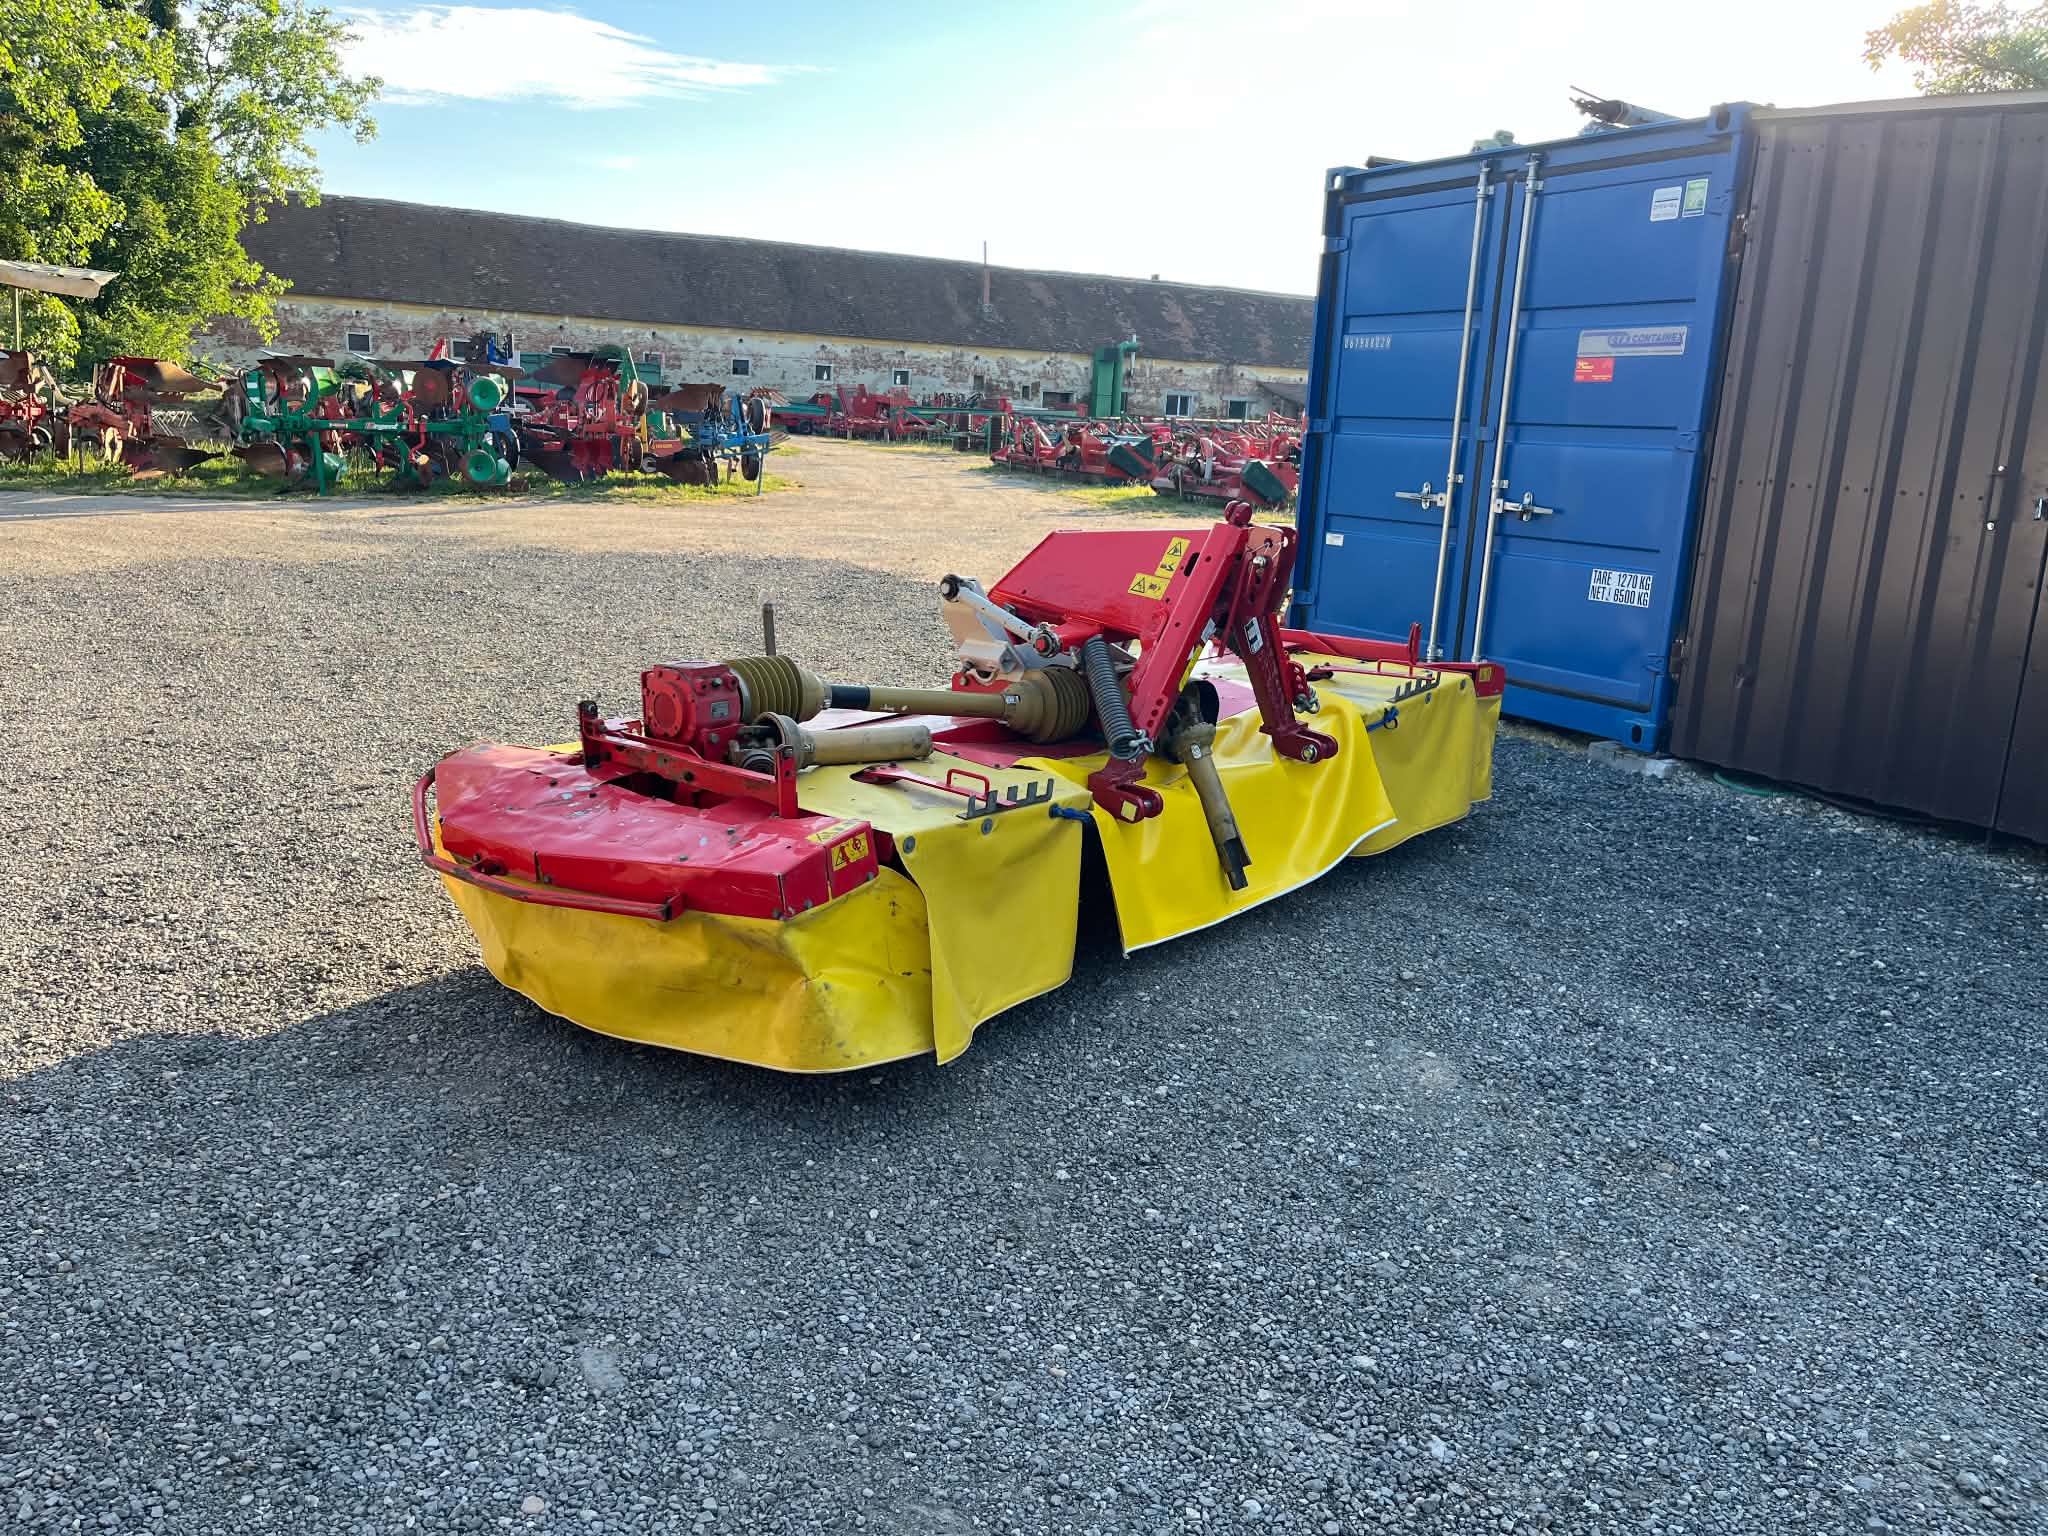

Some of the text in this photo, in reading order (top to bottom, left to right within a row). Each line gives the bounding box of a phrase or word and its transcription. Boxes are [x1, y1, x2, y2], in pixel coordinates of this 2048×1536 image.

[1593, 570, 1651, 591] TARE 1270 KG
[1613, 588, 1636, 605] 6500
[1637, 591, 1649, 607] KG
